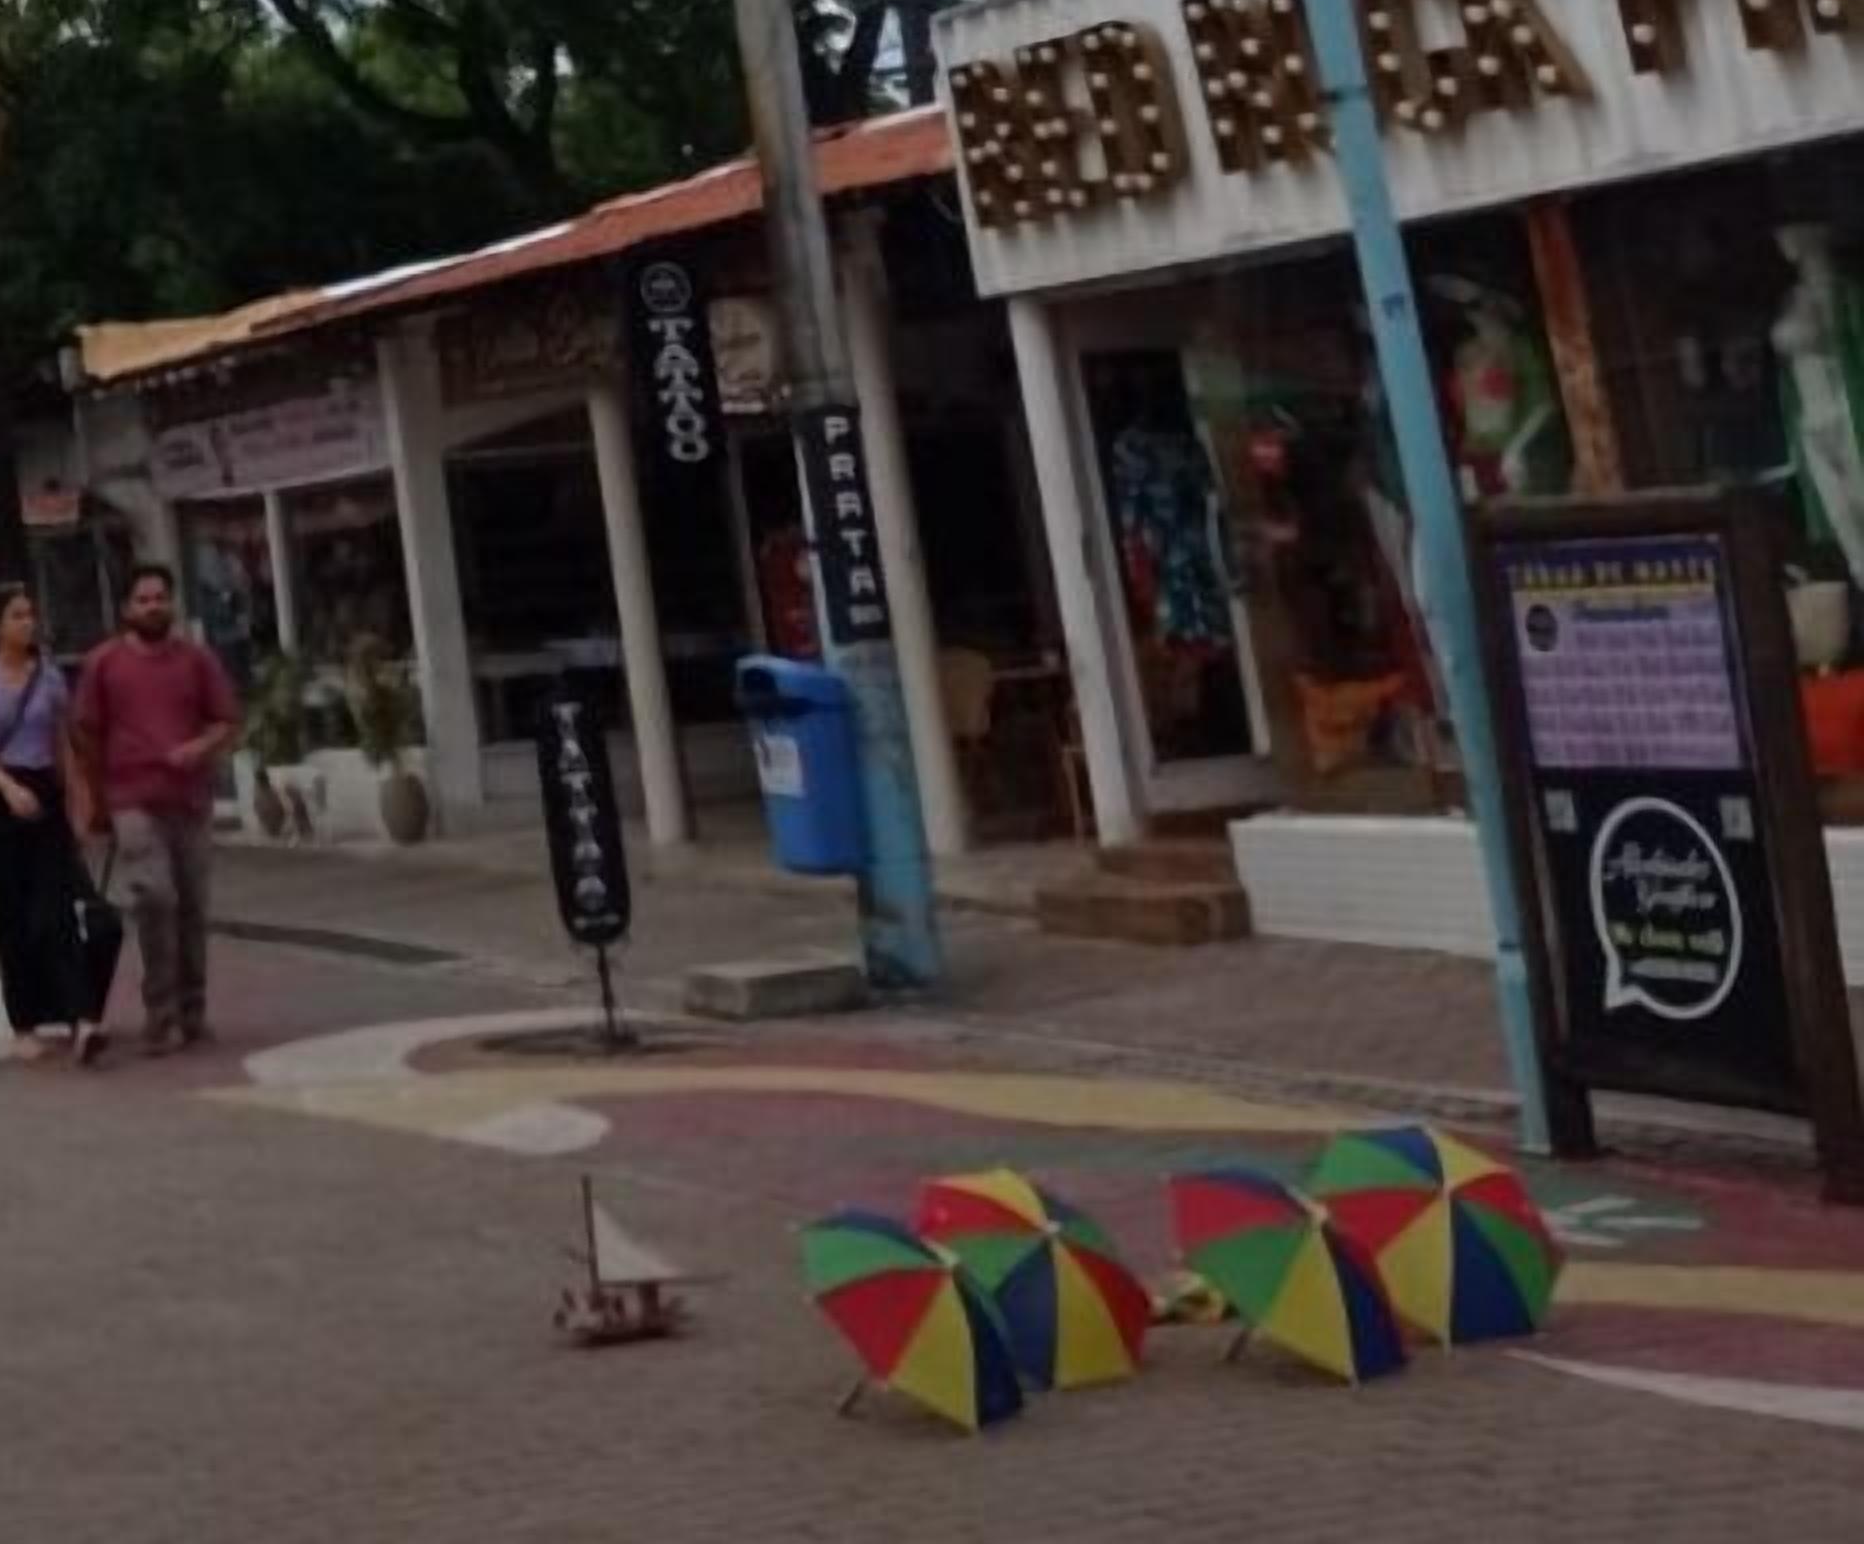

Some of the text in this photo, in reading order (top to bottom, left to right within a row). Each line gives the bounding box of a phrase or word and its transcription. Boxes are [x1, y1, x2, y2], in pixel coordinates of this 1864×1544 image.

[948, 20, 1191, 228] RED
[648, 317, 710, 462] TATTOO
[824, 416, 877, 597] PRATA
